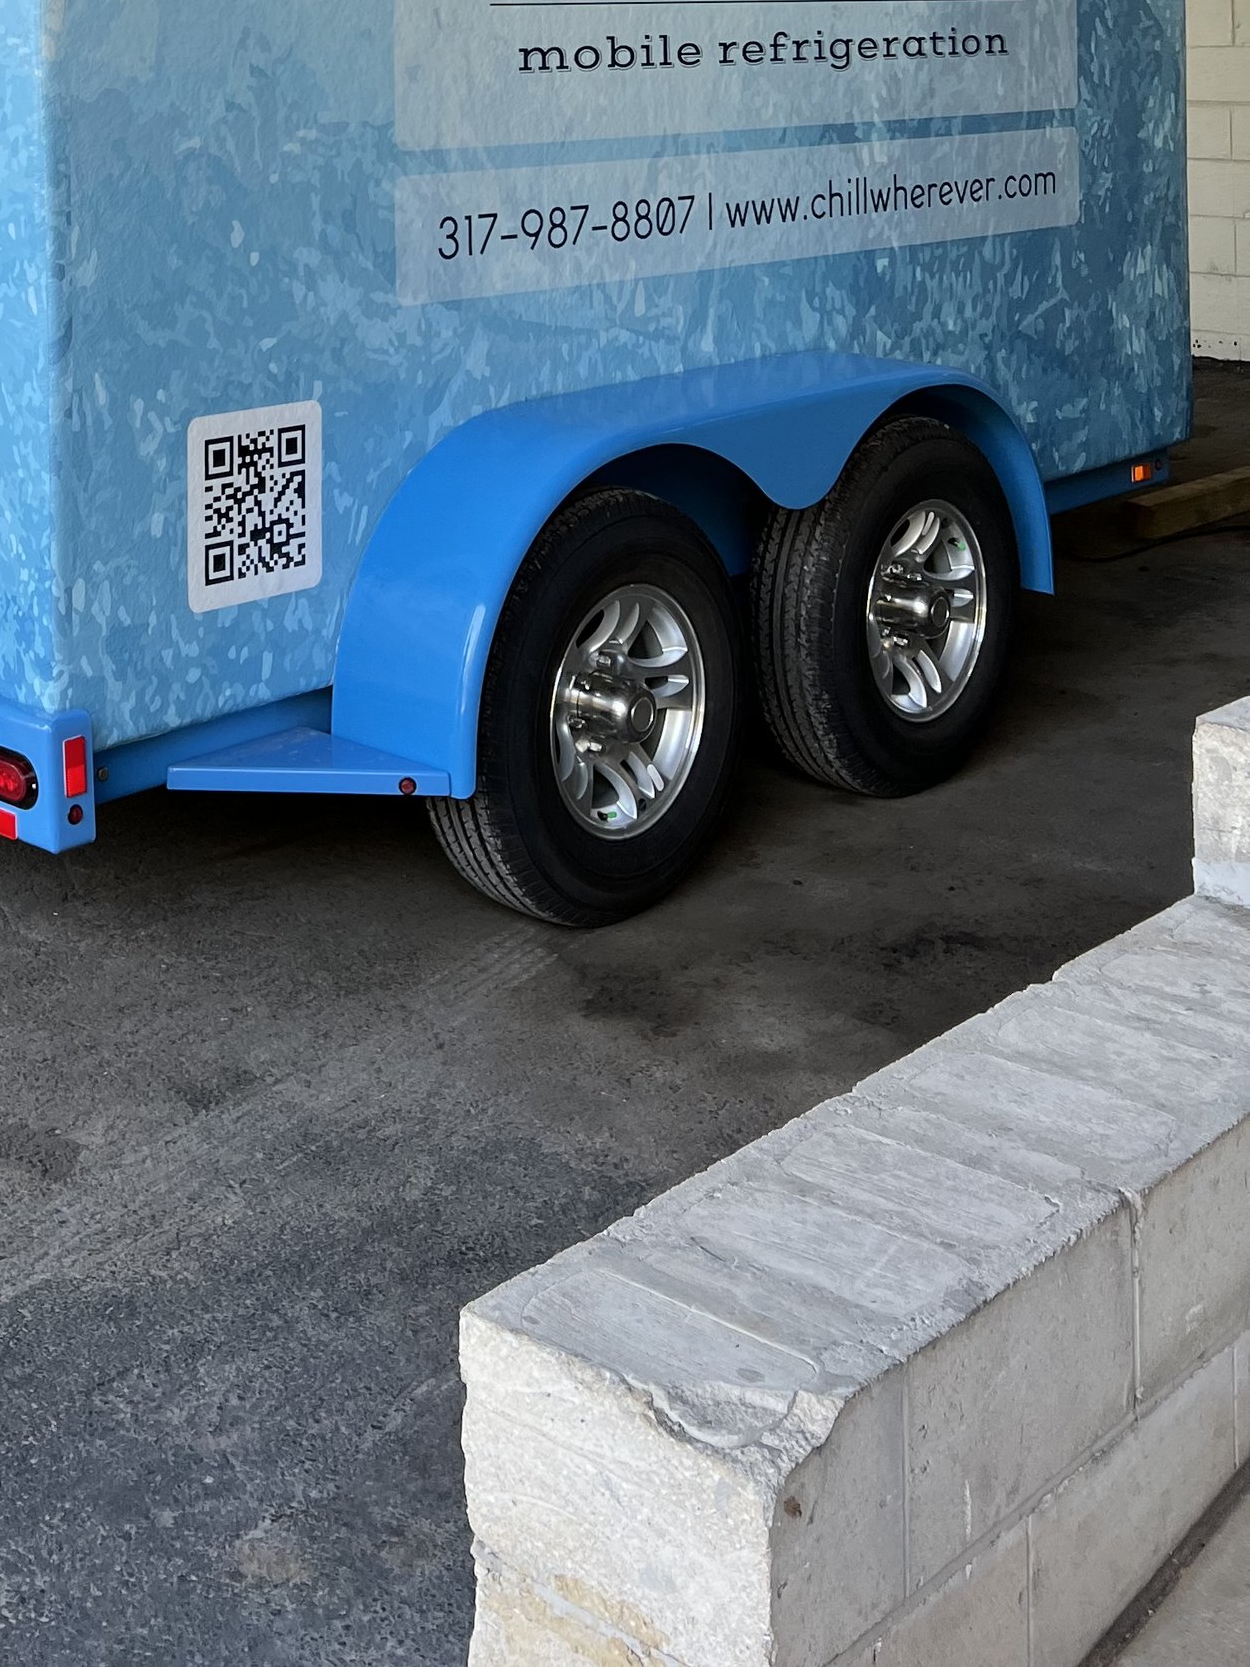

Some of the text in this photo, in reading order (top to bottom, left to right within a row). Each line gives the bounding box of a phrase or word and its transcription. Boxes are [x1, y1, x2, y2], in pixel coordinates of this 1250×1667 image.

[518, 28, 1009, 72] mobile refrigeration
[438, 166, 1057, 260] 317-987-8807 www.chillwherever.com
